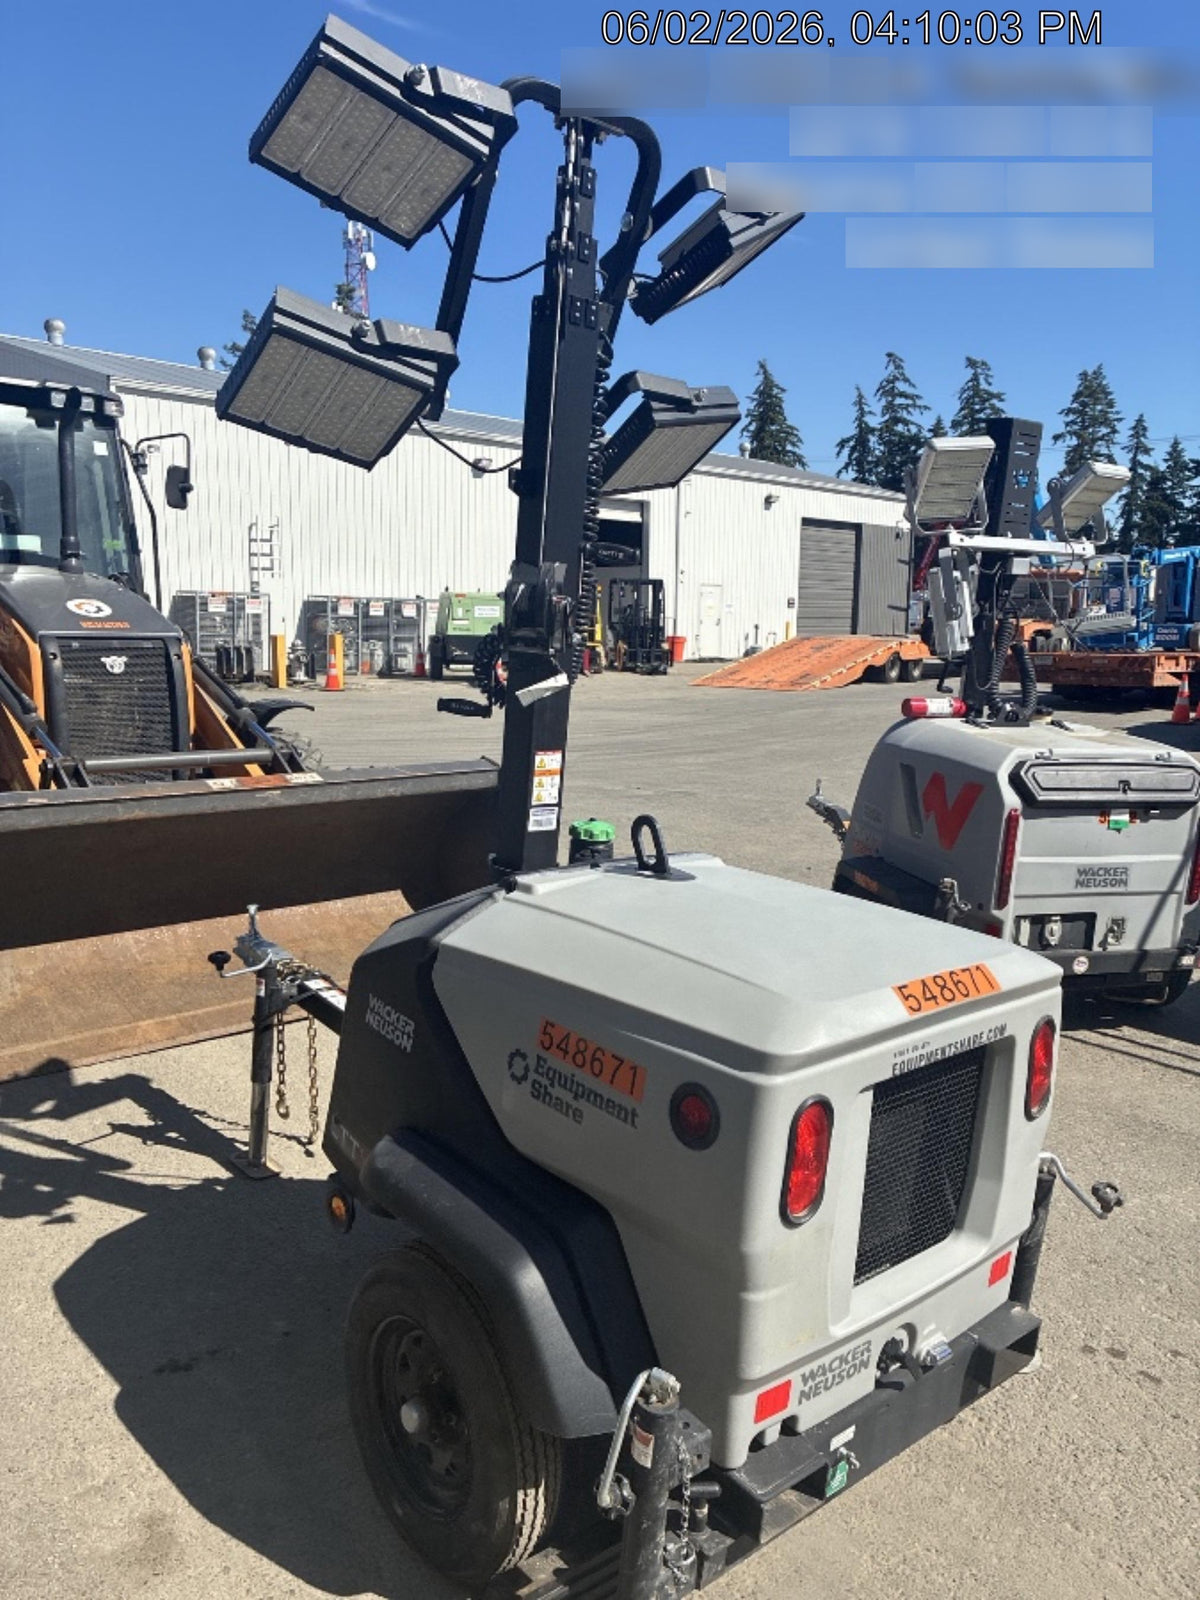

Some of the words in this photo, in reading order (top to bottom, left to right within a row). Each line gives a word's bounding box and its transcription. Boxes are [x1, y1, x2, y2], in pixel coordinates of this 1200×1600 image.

[1074, 878, 1128, 889] NEUSON
[1076, 867, 1129, 878] WACKER
[897, 965, 995, 1012] 548671
[365, 1008, 414, 1053] NEUSON
[368, 993, 415, 1037] WACKER
[540, 1020, 638, 1096] 548671
[892, 1023, 1008, 1077] EQUIPMENTSHARE.COM
[530, 1079, 584, 1125] Share
[533, 1054, 639, 1129] Equipment
[798, 1356, 871, 1406] NEUSON
[801, 1340, 872, 1385] WACKER
